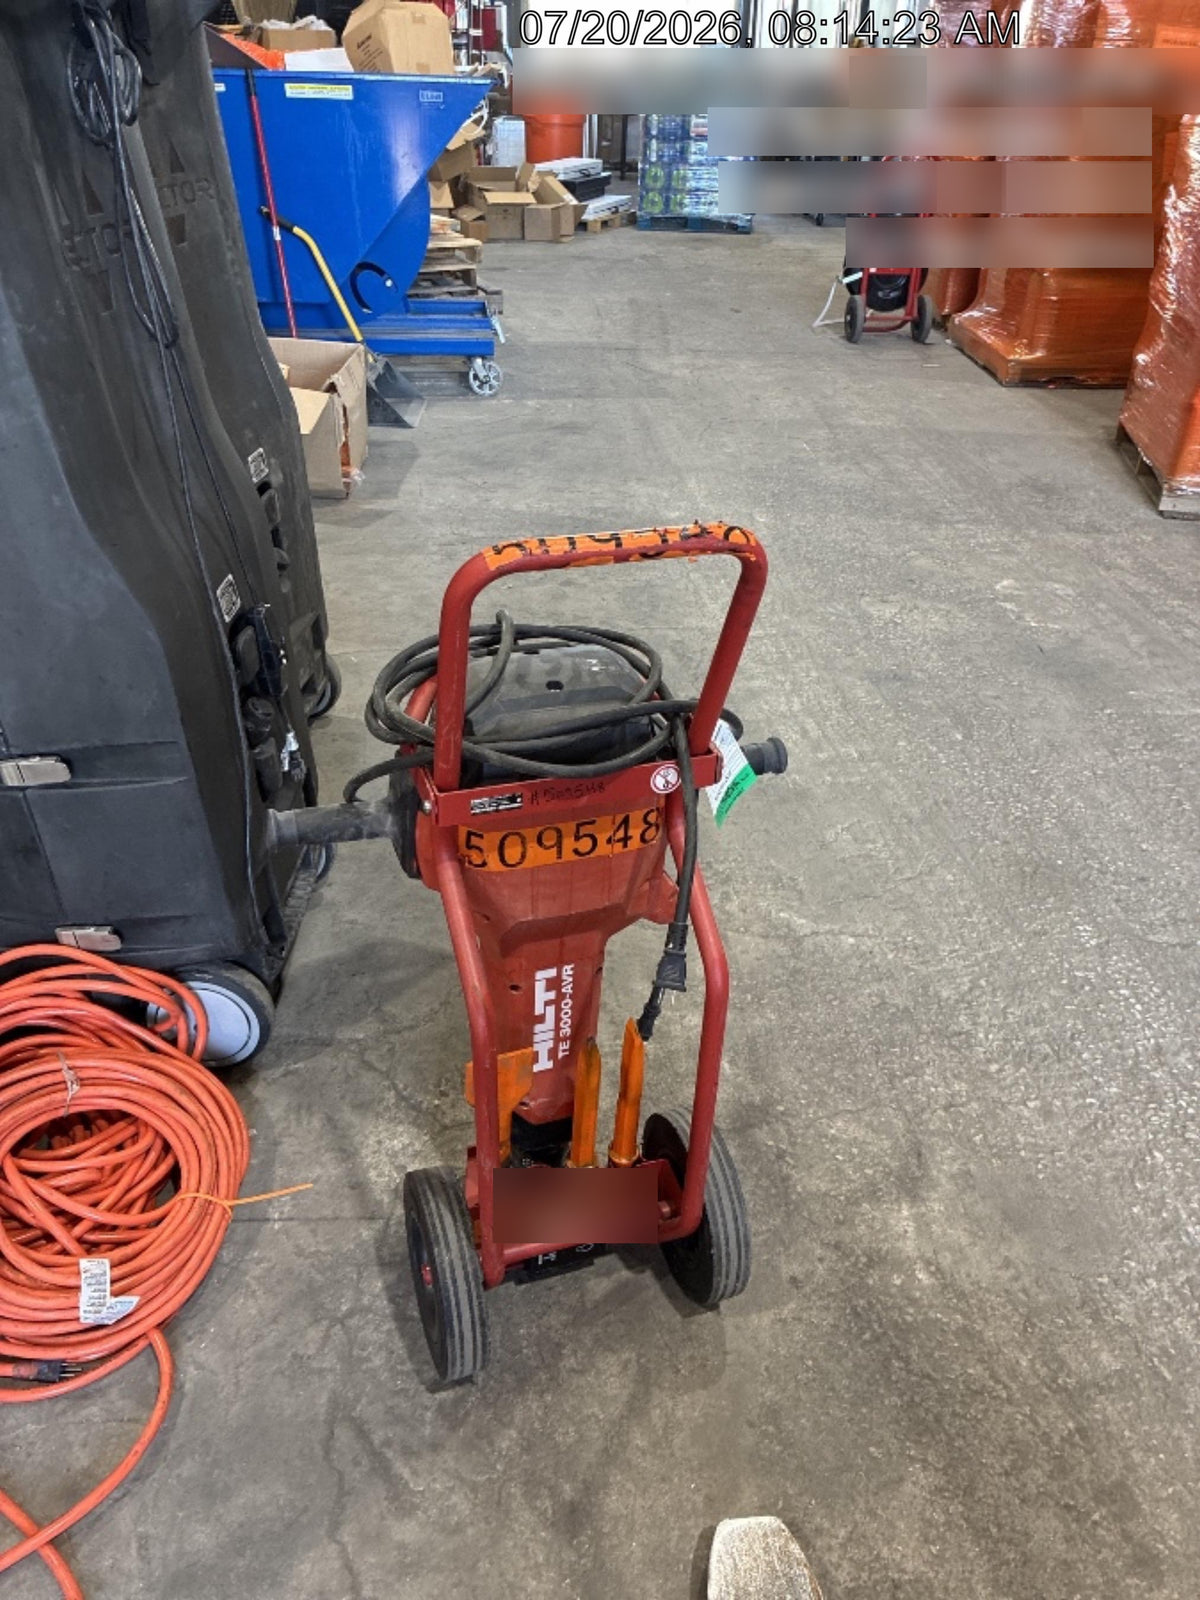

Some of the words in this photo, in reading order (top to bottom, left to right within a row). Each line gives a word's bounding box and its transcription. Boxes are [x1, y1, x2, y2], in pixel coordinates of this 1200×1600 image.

[465, 807, 660, 868] 509548
[532, 967, 557, 1073] HILTI
[560, 963, 574, 1038] 3000-AVR
[558, 1039, 570, 1060] TE
